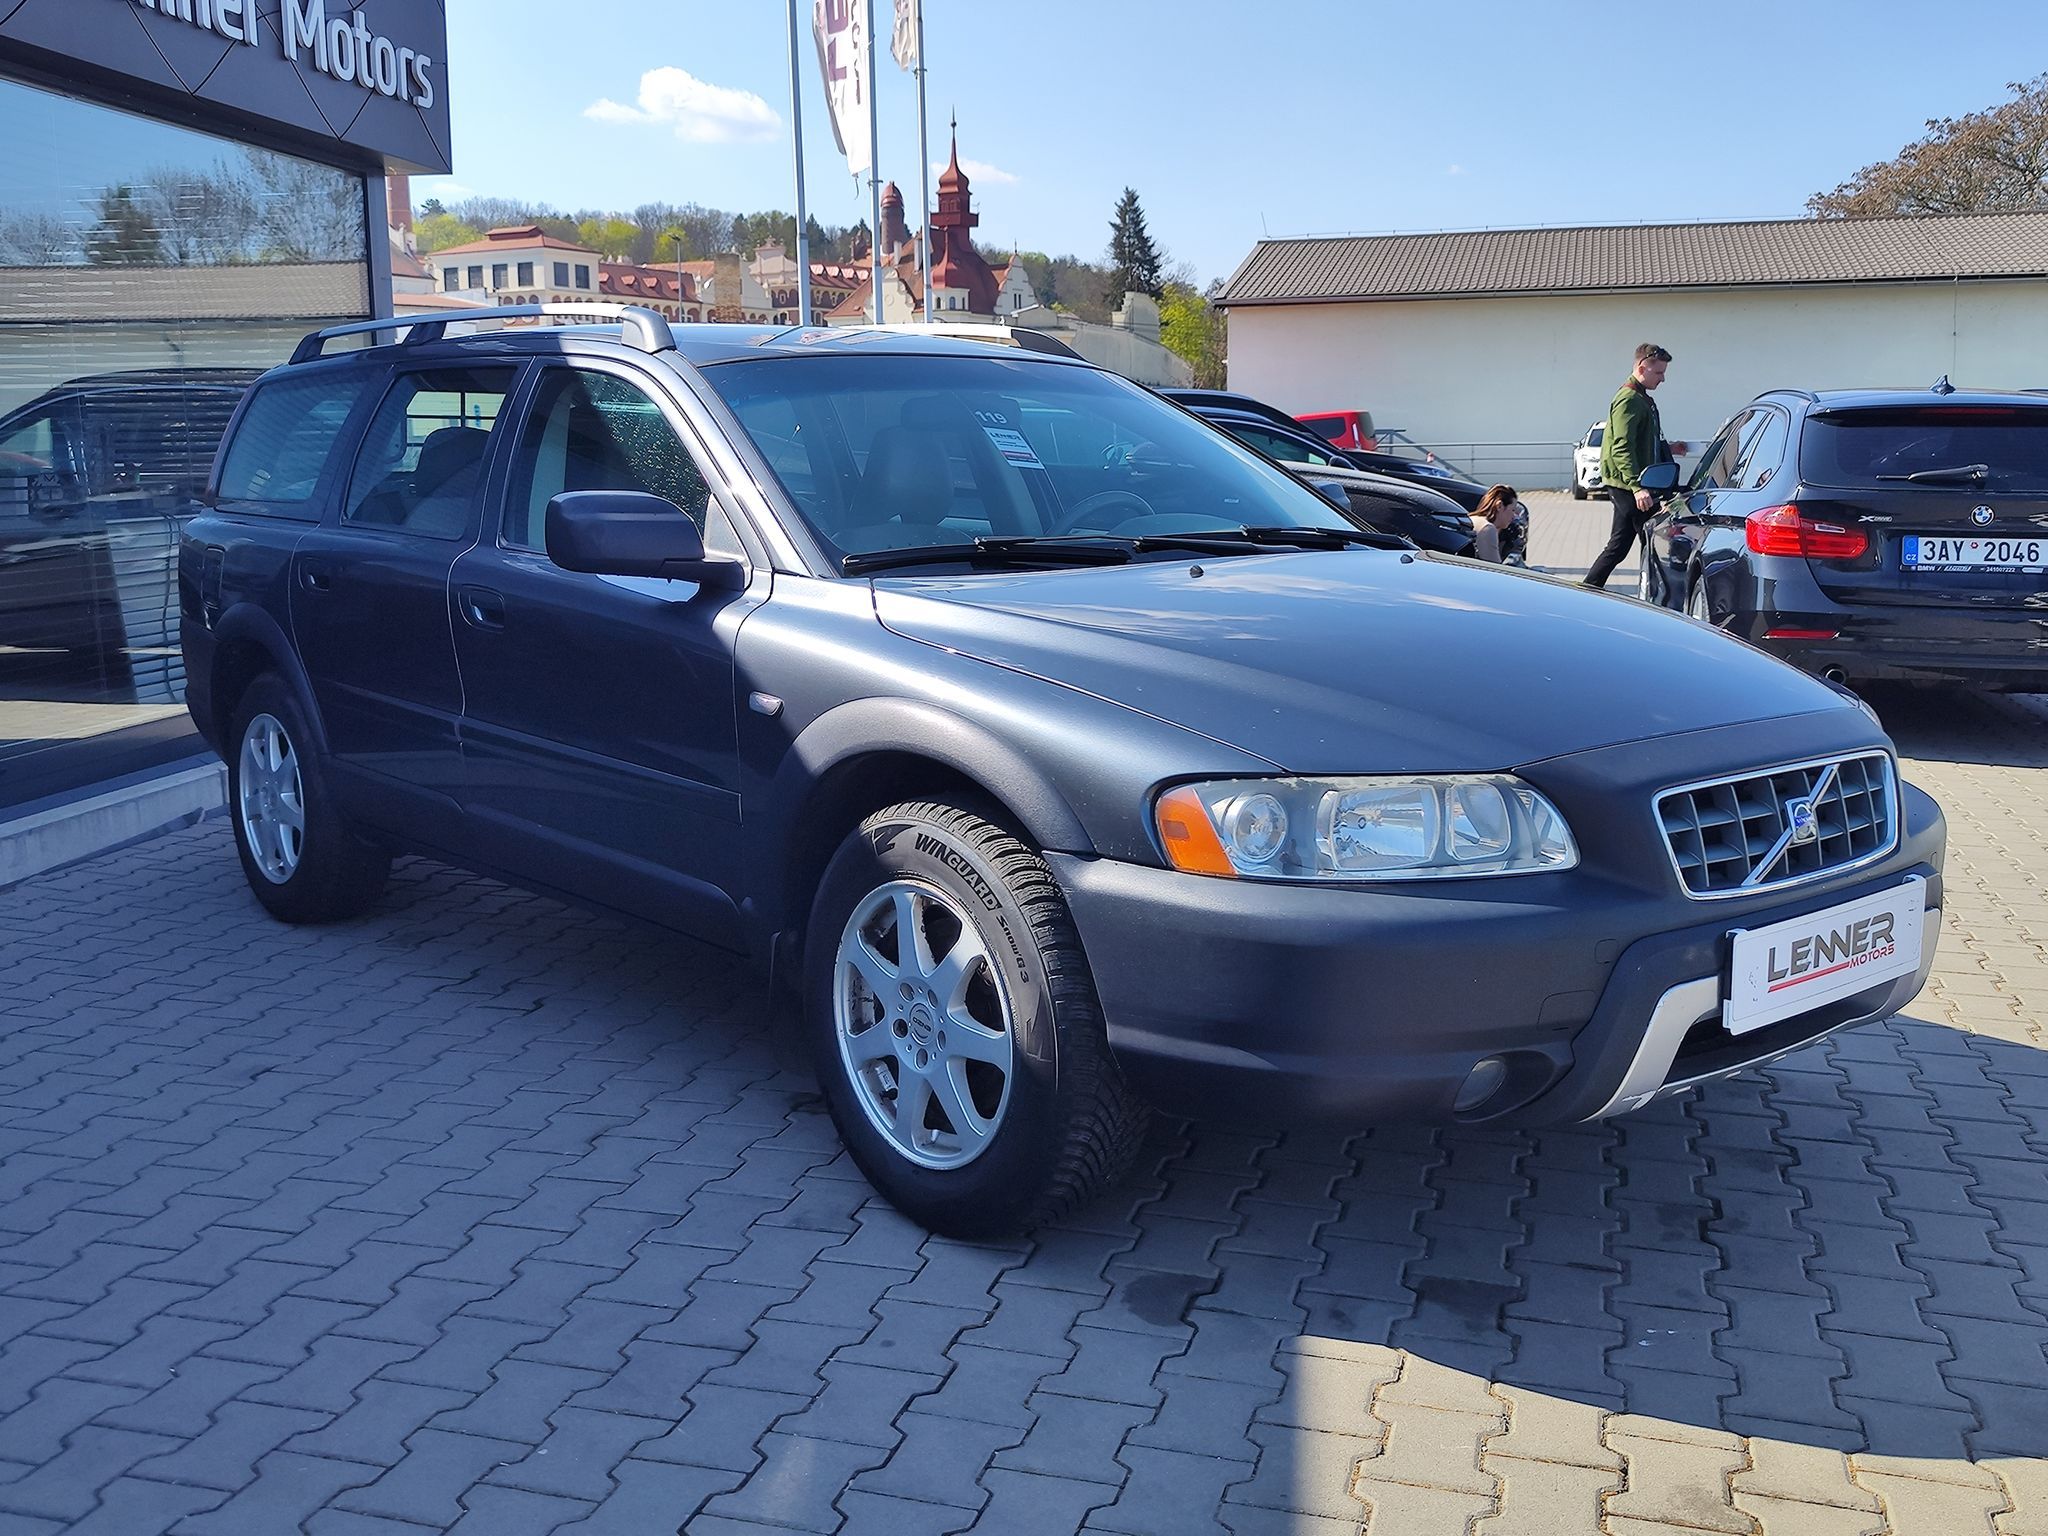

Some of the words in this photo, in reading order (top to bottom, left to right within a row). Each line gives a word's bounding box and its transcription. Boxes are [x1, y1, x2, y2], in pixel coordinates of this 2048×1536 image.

[281, 0, 435, 109] Motors
[1923, 540, 1964, 562] 3AY
[1983, 541, 2040, 563] 2046
[914, 833, 1003, 911] WINGUARD
[1767, 911, 1895, 982] LENNER
[1849, 943, 1896, 968] MOTORS
